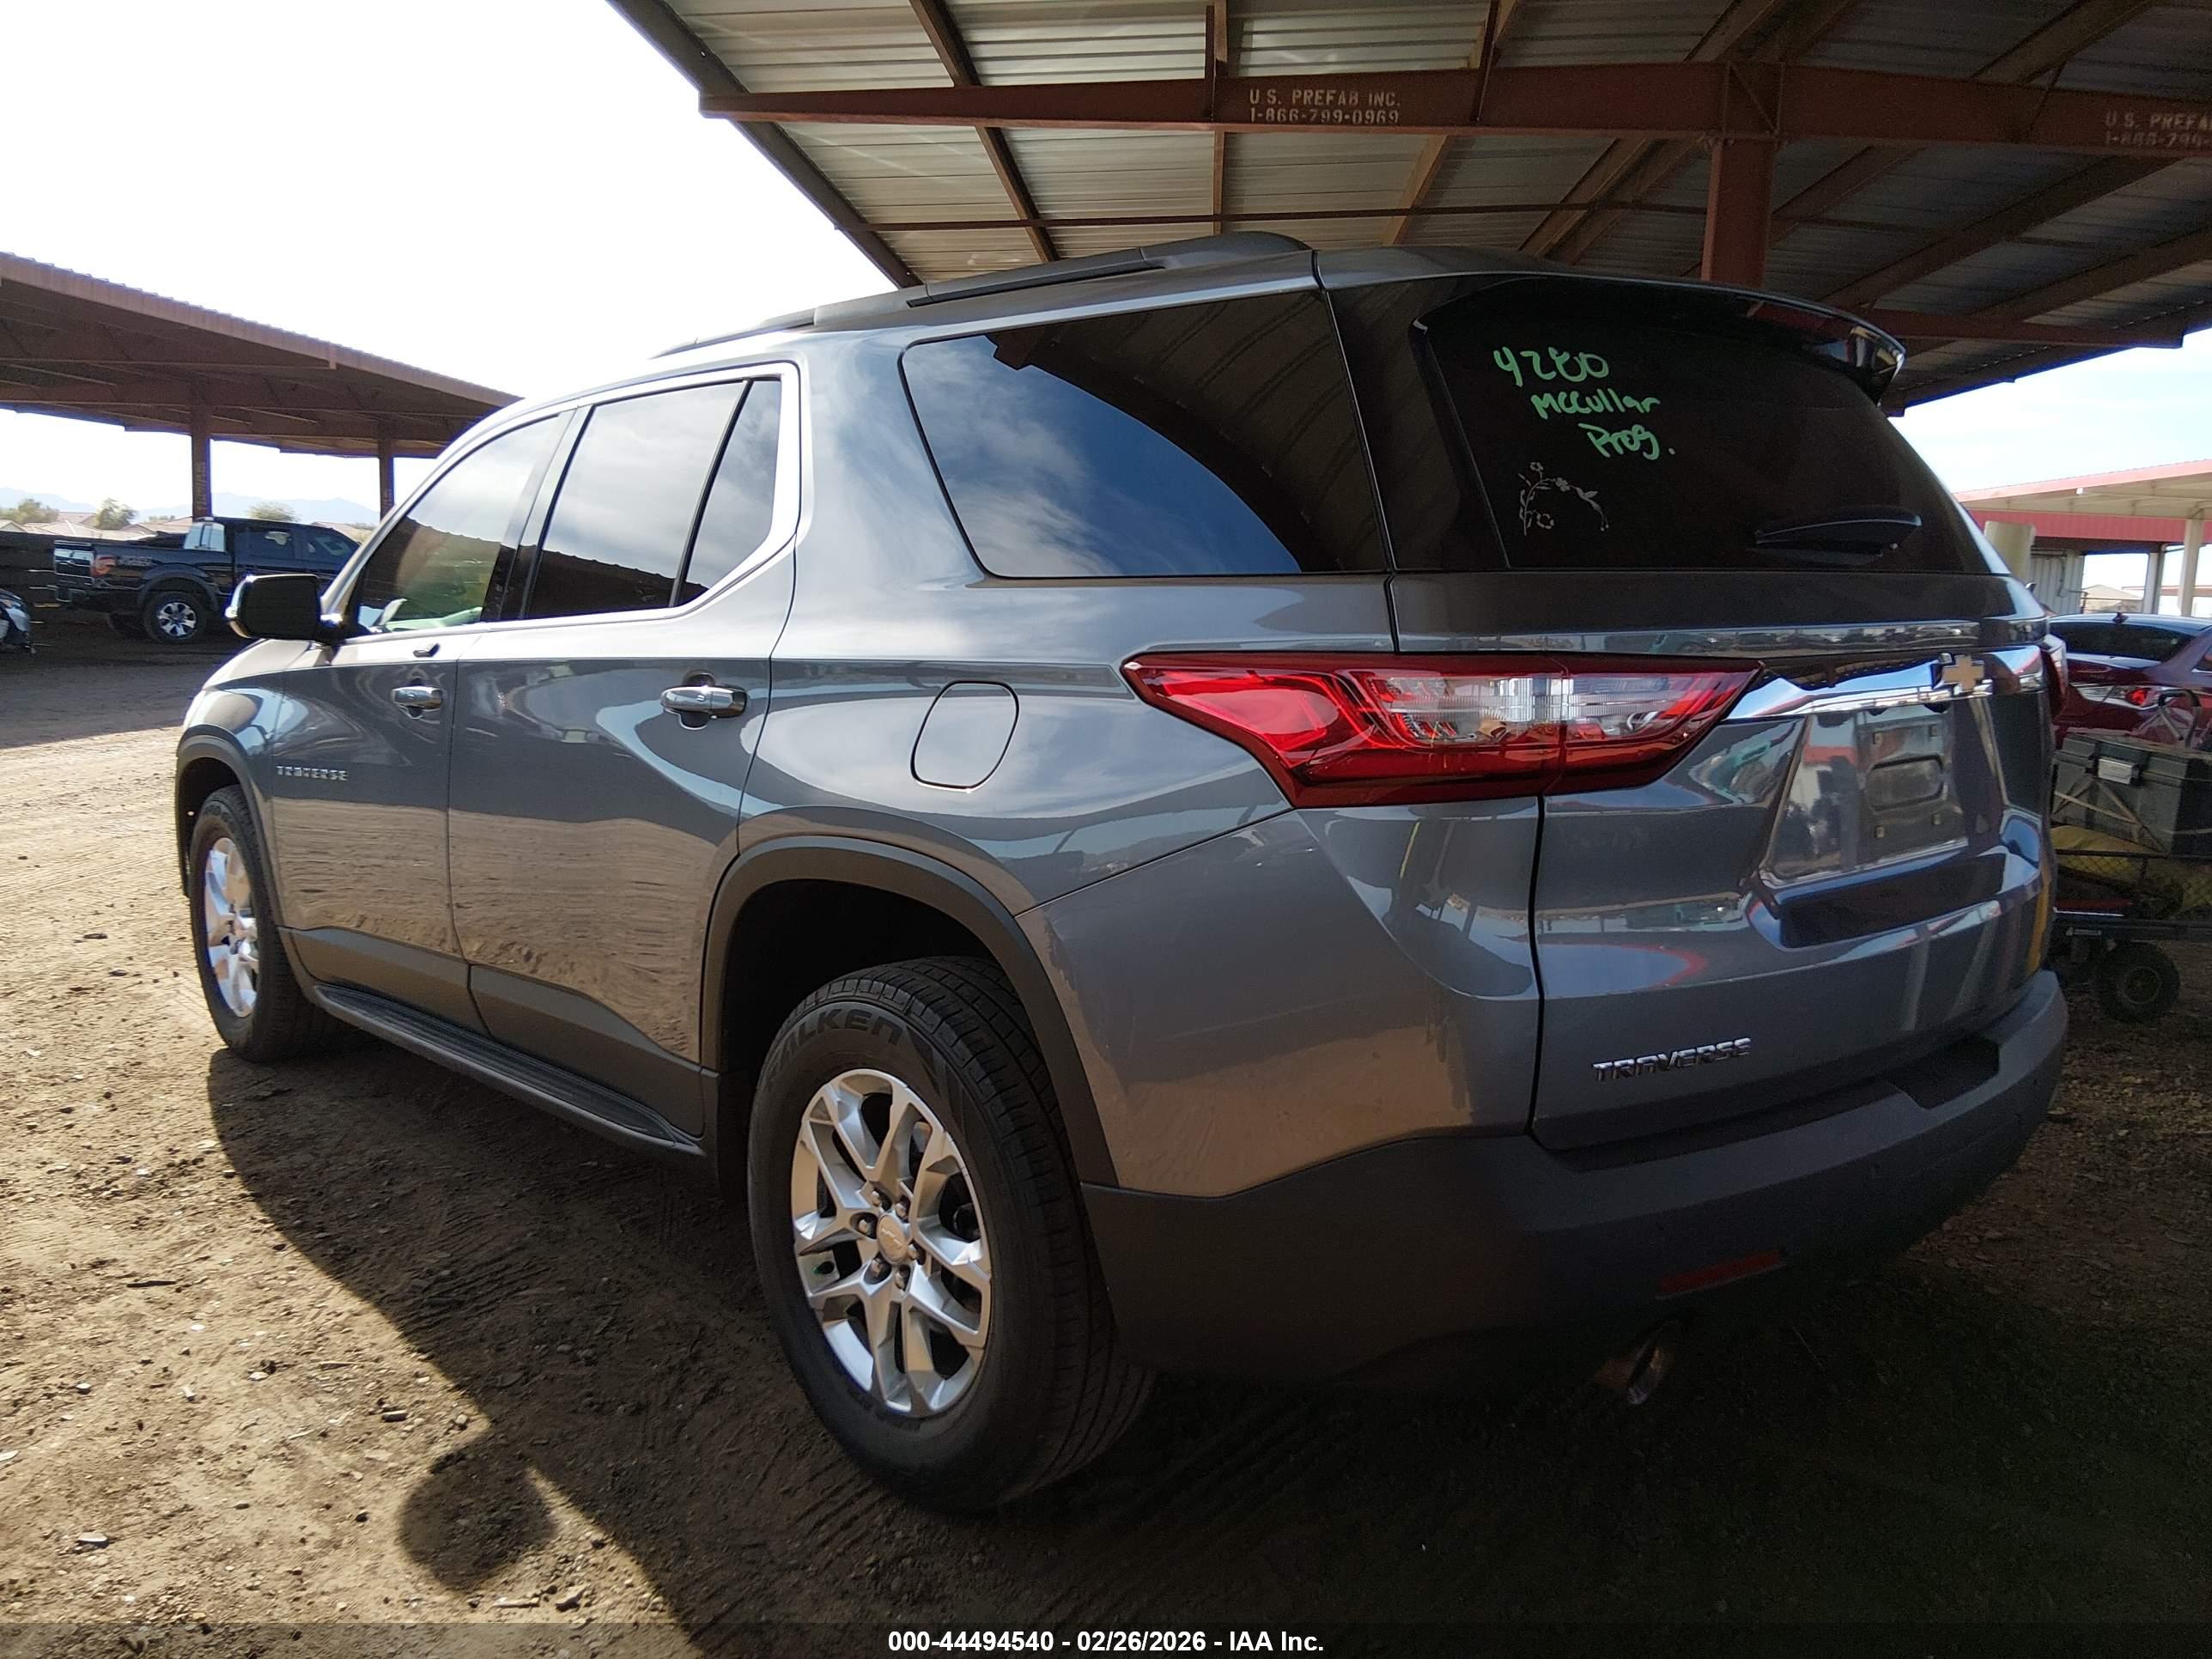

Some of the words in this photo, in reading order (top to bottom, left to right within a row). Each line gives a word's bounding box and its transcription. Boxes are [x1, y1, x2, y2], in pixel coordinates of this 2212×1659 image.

[1291, 89, 1358, 107] PREFAB
[1368, 91, 1401, 107] INC.
[1250, 107, 1399, 125] 1-866-799-0969
[773, 1007, 904, 1070] ALKEN
[1592, 1037, 1752, 1081] TRAVERSE
